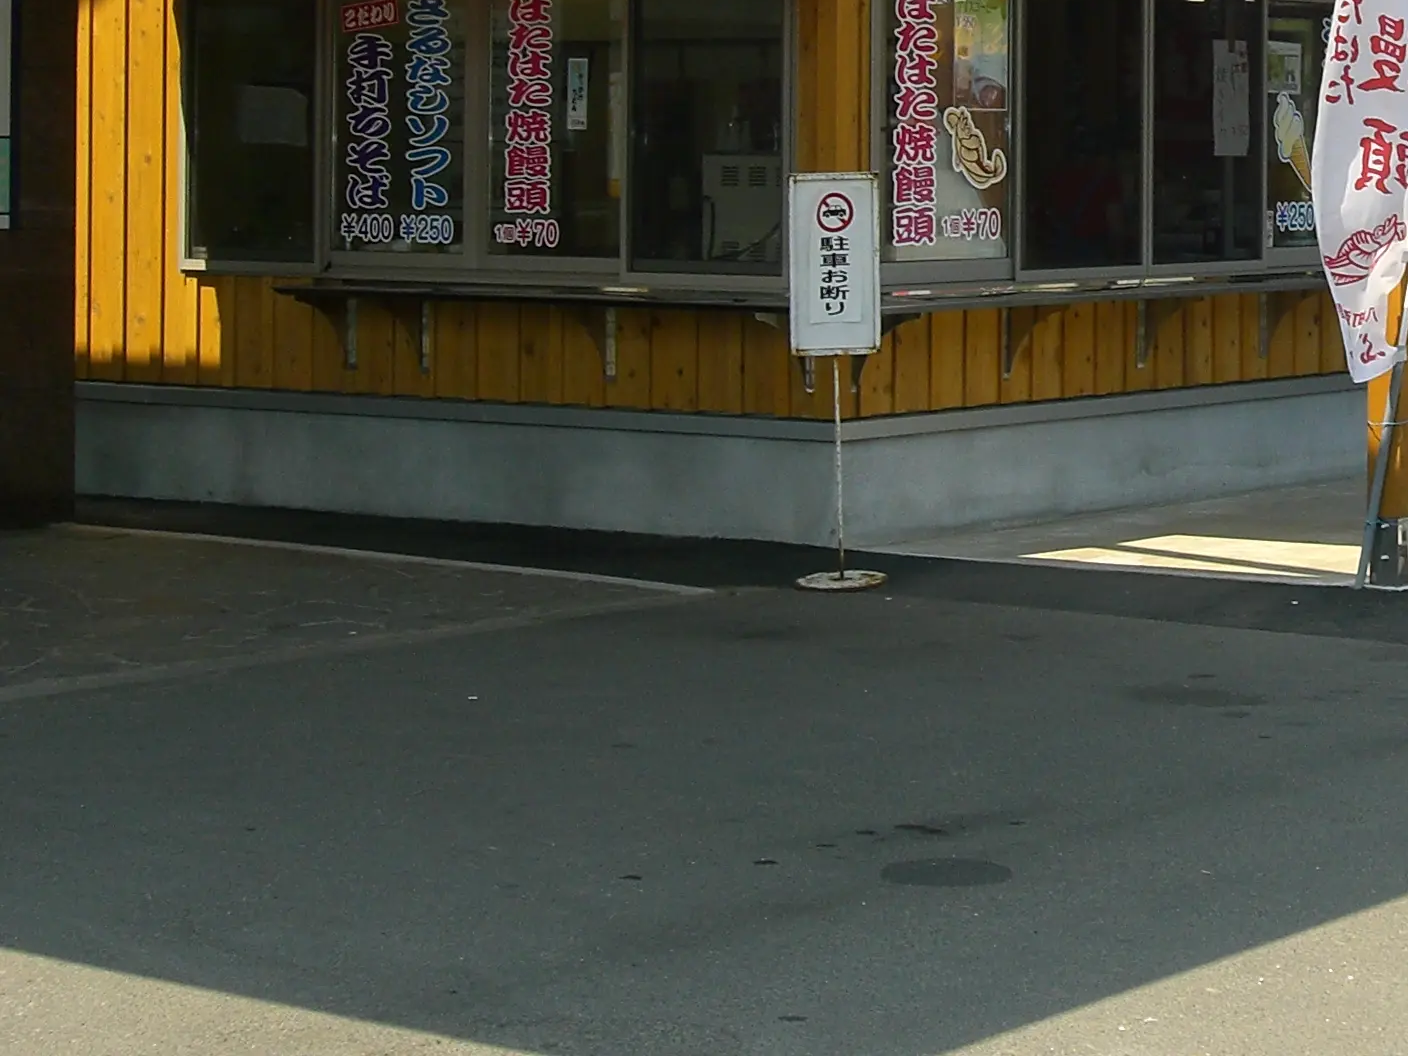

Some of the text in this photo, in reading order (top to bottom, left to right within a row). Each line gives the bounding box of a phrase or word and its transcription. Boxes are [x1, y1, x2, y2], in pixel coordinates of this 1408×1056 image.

[344, 2, 397, 29] こだわり
[346, 32, 393, 209] 手打ちそば
[341, 212, 394, 243] ¥400
[400, 213, 453, 244] ¥250
[1276, 201, 1315, 232] ¥250
[819, 235, 850, 316] 駐車お断り
